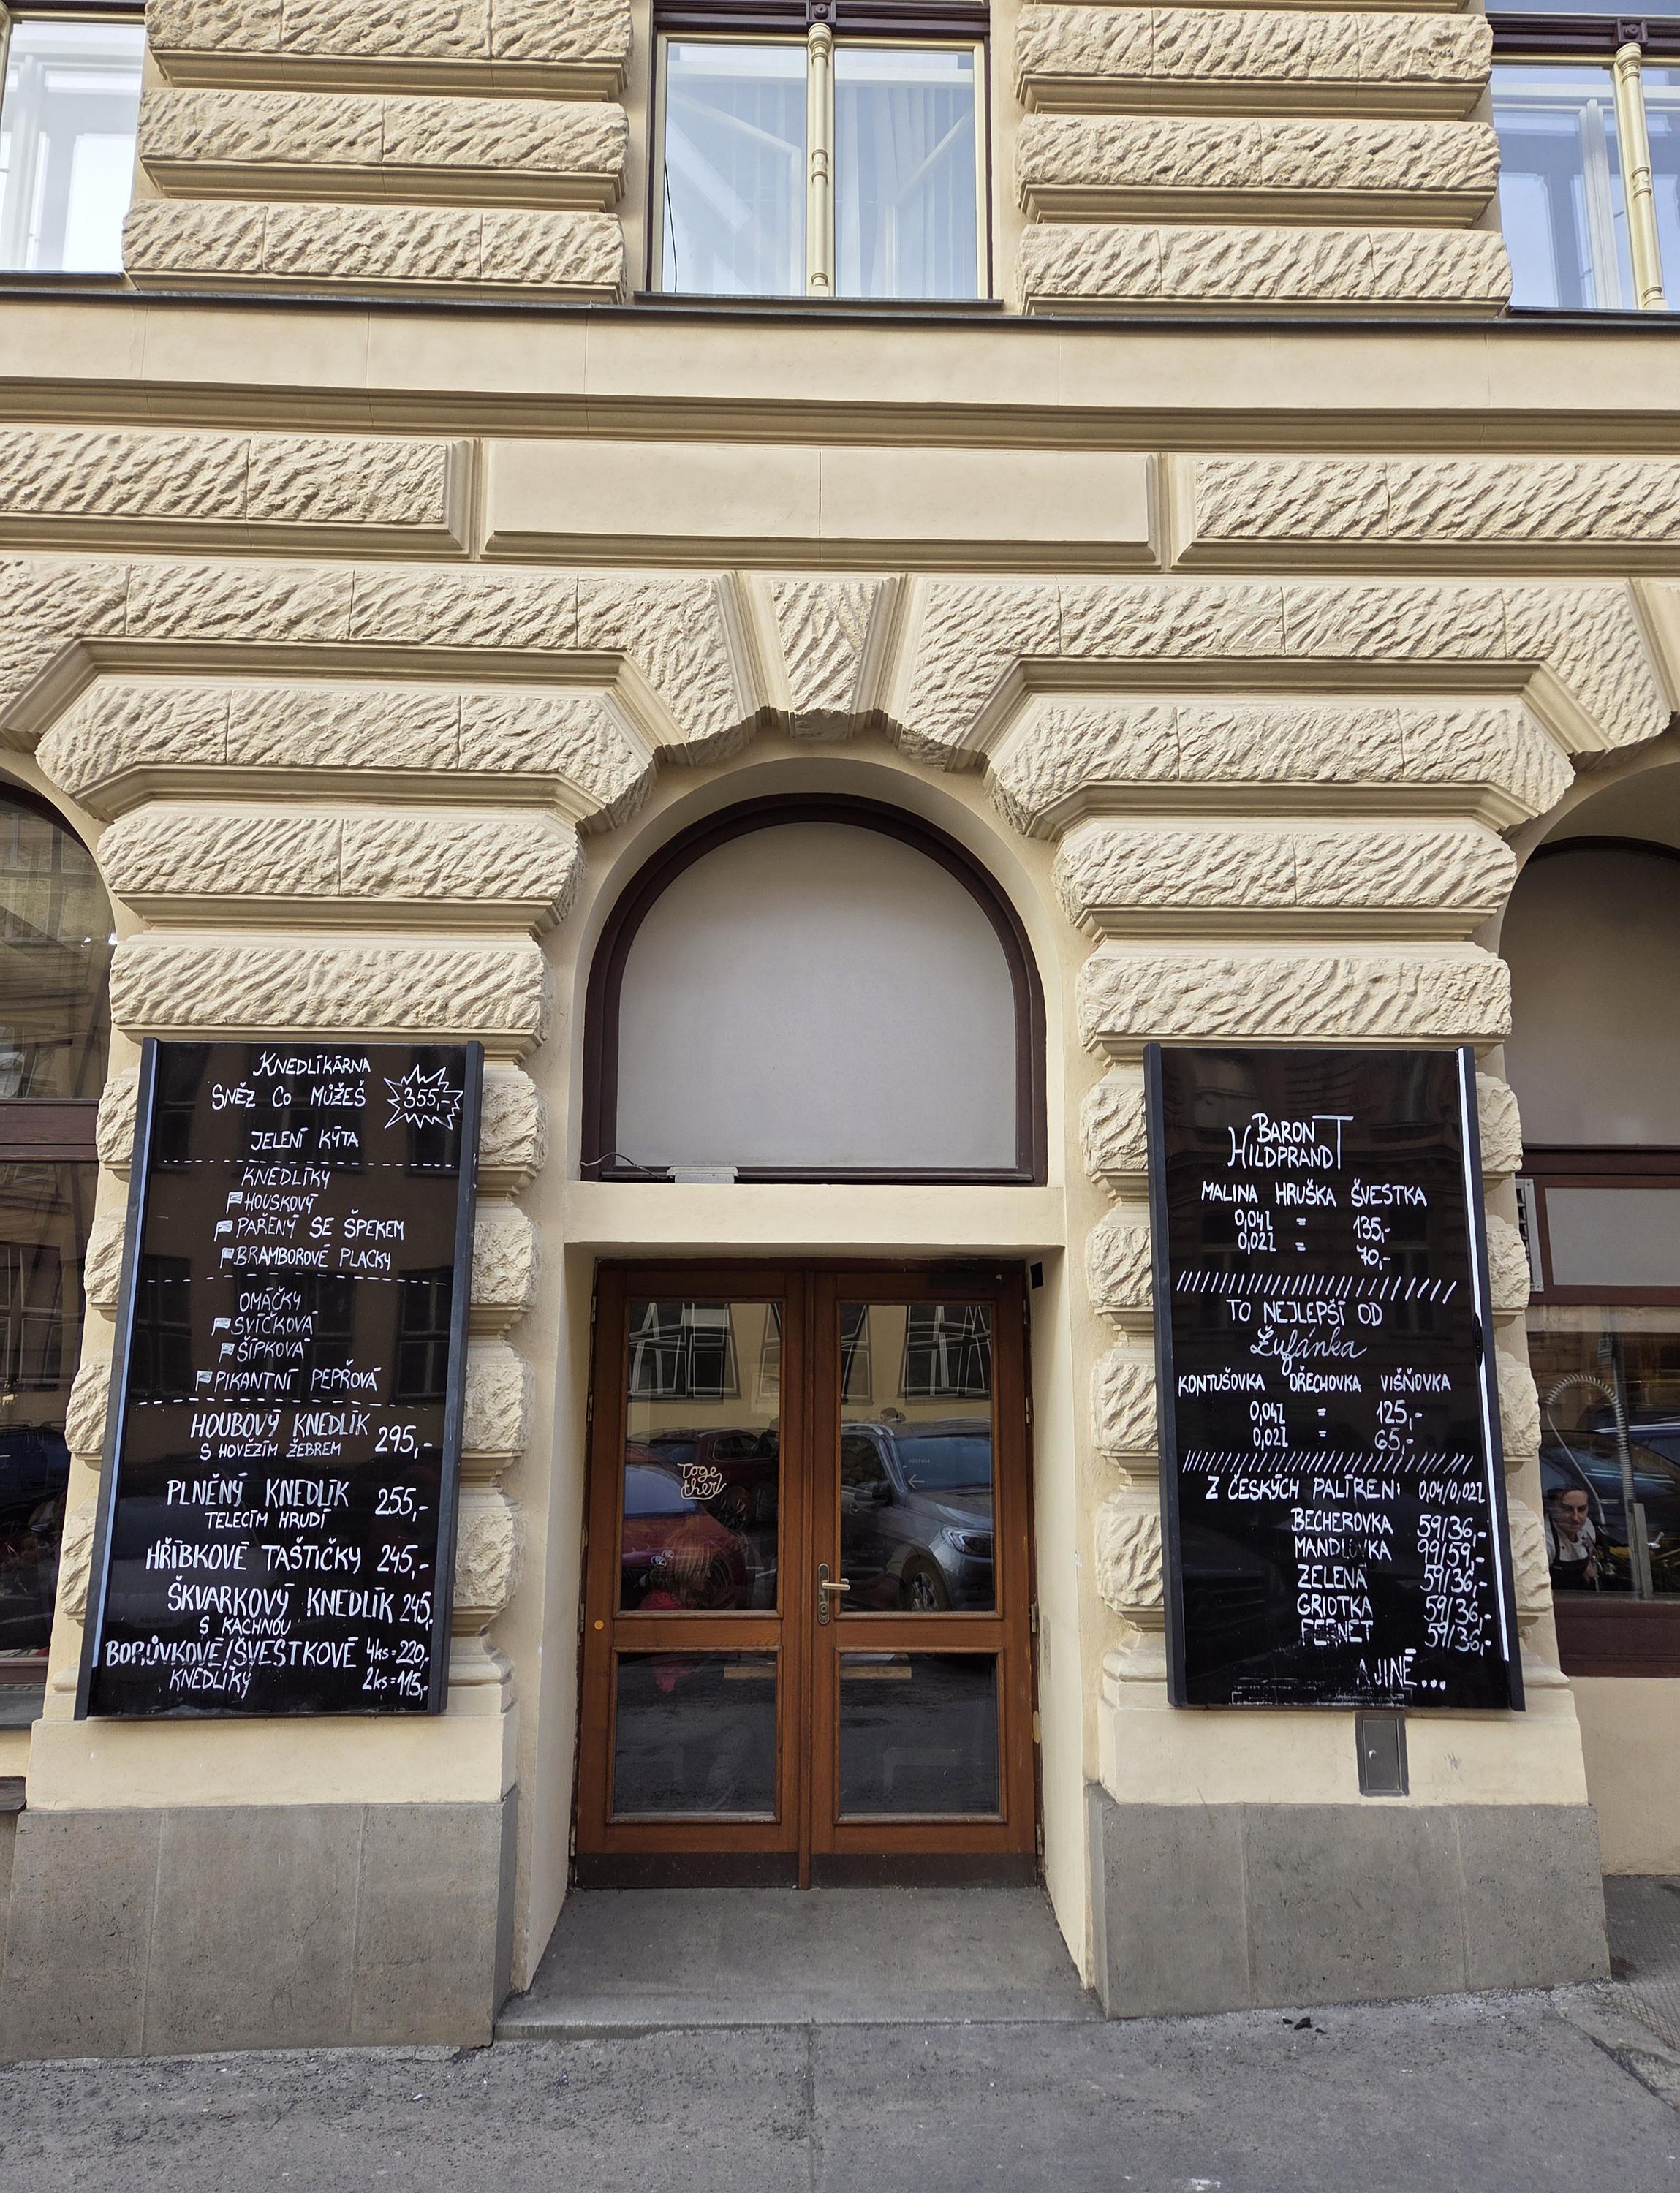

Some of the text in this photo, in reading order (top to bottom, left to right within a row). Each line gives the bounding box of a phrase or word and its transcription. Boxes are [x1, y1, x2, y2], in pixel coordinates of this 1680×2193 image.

[252, 1051, 371, 1077] KNEDLÍKÁRNA
[212, 1083, 256, 1110] SNĚZ
[310, 1080, 366, 1107] MŮŽEŠ
[404, 1086, 450, 1111] 355,-
[251, 1126, 359, 1150] JELENÍ KÝTA
[1252, 1113, 1315, 1143] BARON
[241, 1167, 330, 1190] KNEDLÍKY
[1201, 1178, 1428, 1208] MALINA HRUŠKA ŠVESTKA
[244, 1193, 319, 1214] HOUSKOVÝ
[236, 1210, 404, 1241] PAŘENÝ SE ŠPEKEM
[1353, 1215, 1390, 1243] 135,-
[233, 1244, 391, 1271] BRAMBOROVÉ PLACKY
[1357, 1245, 1391, 1270] 70,-
[239, 1287, 301, 1311] OMÁČKY
[1226, 1299, 1383, 1326] TO NEJLEPŠÍ OD
[230, 1311, 319, 1336] SVÍČKOVÁ
[237, 1336, 311, 1363] ŠÍPKOVÁ
[1249, 1325, 1368, 1376] Žufánka
[214, 1360, 382, 1392] PIKANTNÍ PEPŘOVÁ
[1178, 1365, 1451, 1397] KONTUŠOVKA OŘECHOVKA VIŠŇOVKA
[1376, 1400, 1423, 1431] 125,-
[190, 1409, 434, 1460] HOUBOVÝ KNEDLÍK 295,-
[200, 1437, 342, 1461] S HOVĚZÍM ŽEBREM
[1374, 1428, 1414, 1455] 65,-
[167, 1472, 430, 1523] PLNĚNÝ KNEDLÍK 255,-
[1206, 1476, 1219, 1500] Z
[1227, 1474, 1300, 1501] ČESKÝCH
[204, 1509, 332, 1529] TELECÍM HRUDÍ
[1290, 1507, 1487, 1548] BECHEROVKA 59/36,-
[145, 1537, 430, 1580] HŘÍBKOVÉ TAŠTIČKY 245,-
[1417, 1539, 1485, 1572] 99/59,-
[1297, 1562, 1488, 1599] ZELENÁ 59/36,-
[167, 1575, 295, 1620] ŠKVARKOVÝ
[306, 1586, 395, 1624] KNEDLÍK
[1296, 1593, 1492, 1632] GRIOTKA 59/36,-
[199, 1615, 291, 1637] S KACHNOU
[1424, 1621, 1491, 1656] 59/36,-
[169, 1665, 252, 1700] KNEDLÍKY
